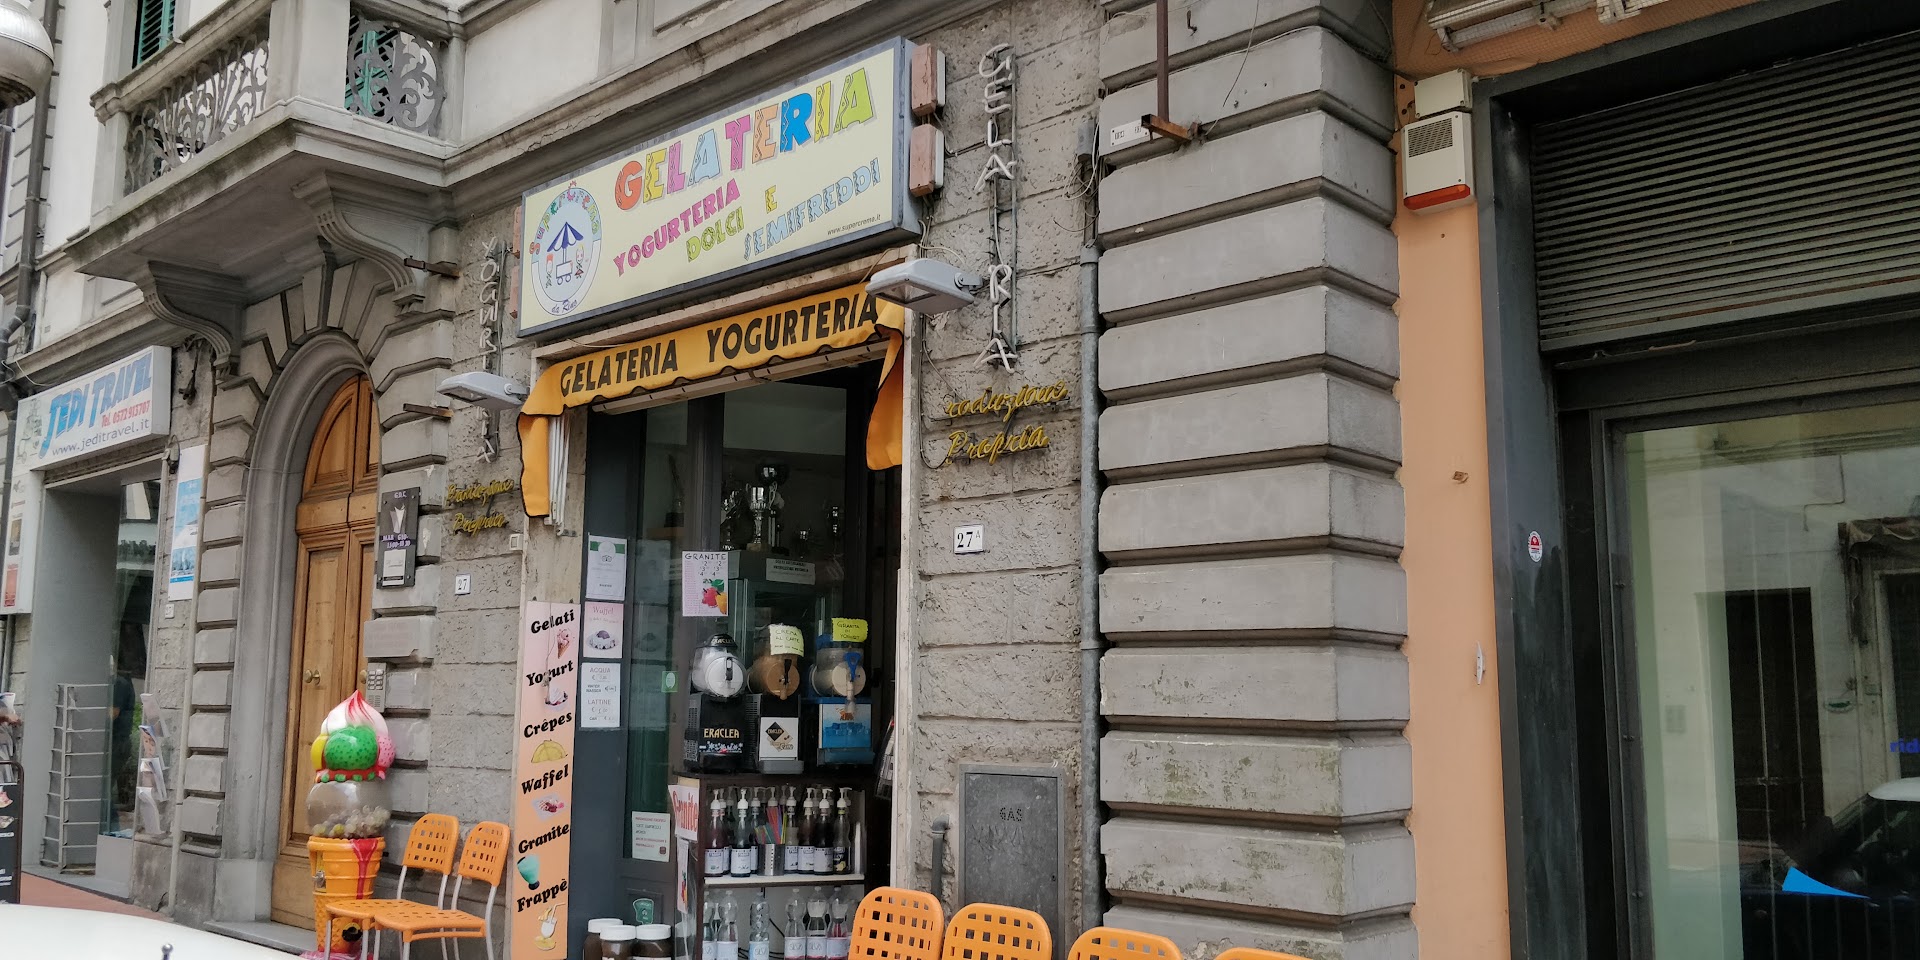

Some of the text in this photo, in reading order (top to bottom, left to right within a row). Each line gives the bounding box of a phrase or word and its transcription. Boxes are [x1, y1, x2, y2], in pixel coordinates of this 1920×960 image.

[614, 67, 876, 211] GELATERIA
[744, 157, 881, 261] SEMIFREDDI
[765, 185, 778, 214] E
[613, 178, 741, 277] YOGURTERIA
[685, 206, 745, 263] DOLCI
[706, 293, 878, 364] YOGURTERIA
[560, 338, 679, 398] GELATERIA
[38, 351, 153, 460] JEDI TRAVEL
[51, 418, 150, 457] www.jeditravel.it
[457, 578, 468, 591] 27
[530, 608, 575, 635] Gelati
[523, 711, 573, 739] Crêpes
[703, 728, 740, 739] ERACLEA
[521, 763, 569, 796] Waffel
[999, 807, 1023, 822] GAS
[518, 822, 570, 854] Granite
